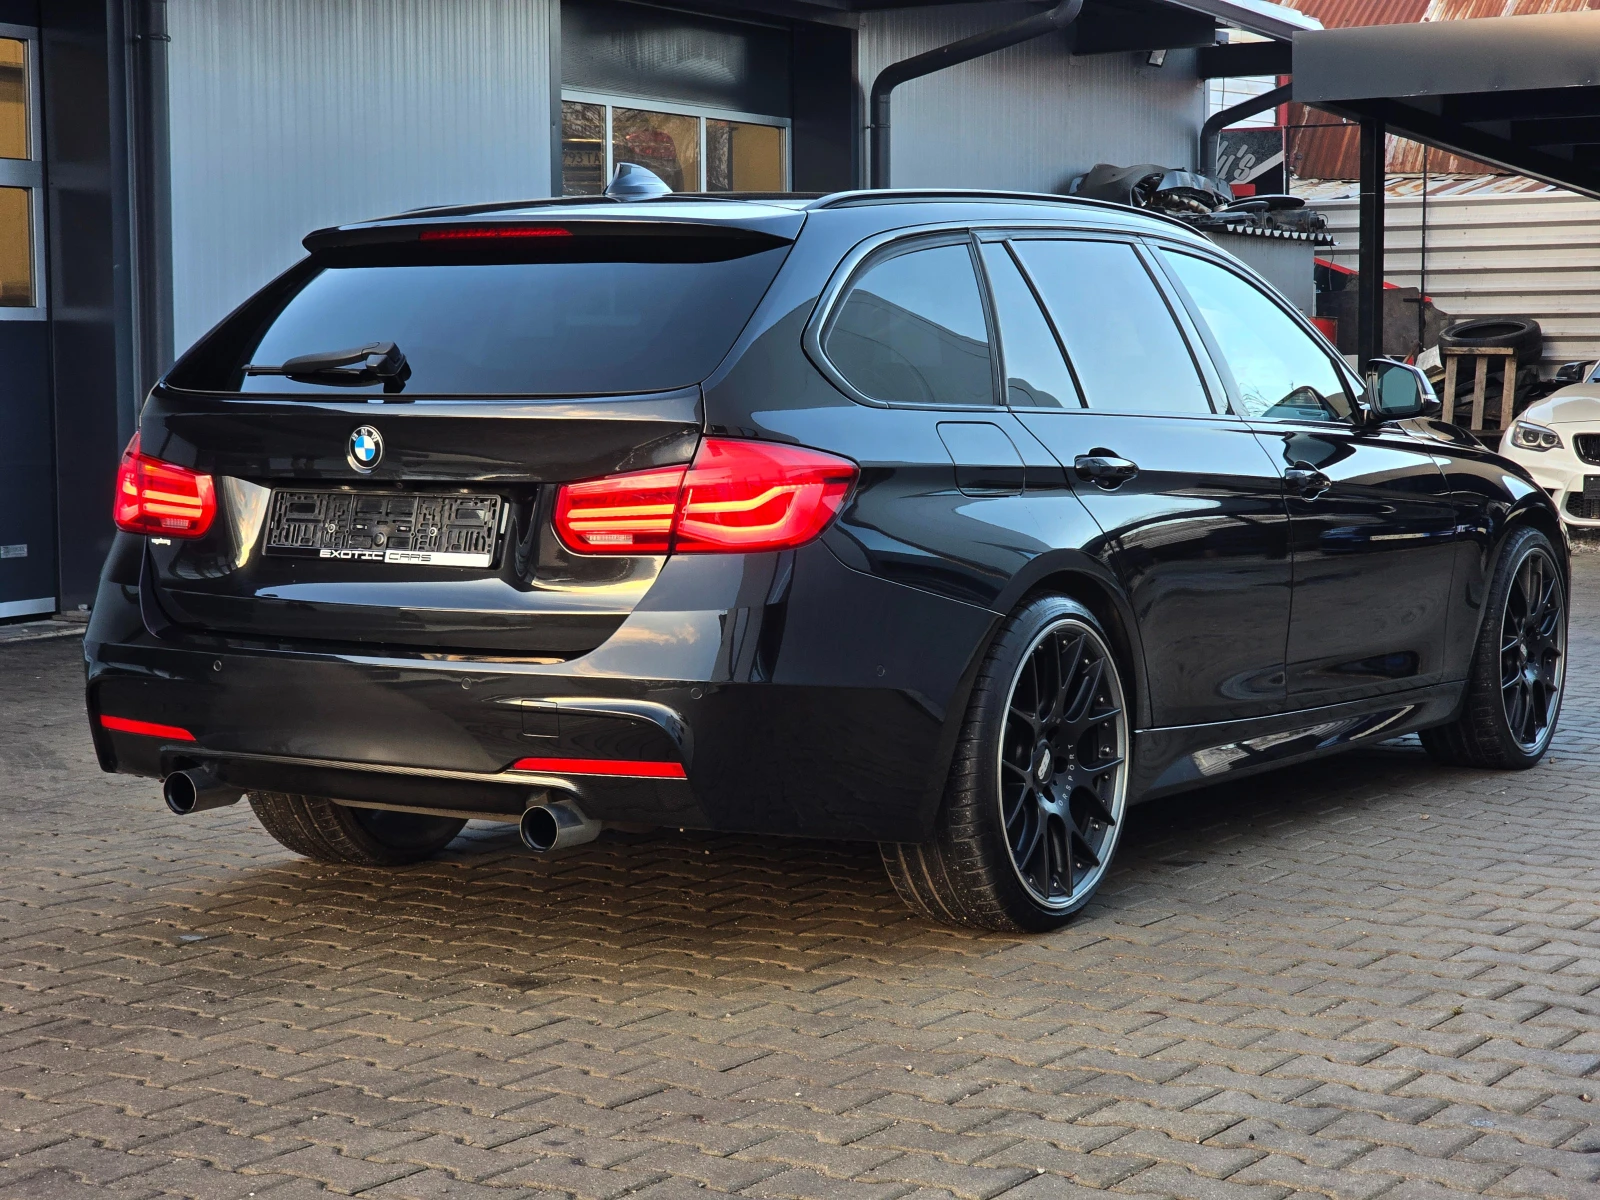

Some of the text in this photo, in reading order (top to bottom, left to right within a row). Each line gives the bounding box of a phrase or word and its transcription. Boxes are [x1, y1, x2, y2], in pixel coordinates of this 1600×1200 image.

[351, 428, 379, 442] BMW
[320, 549, 432, 562] EXOTIC CARS
